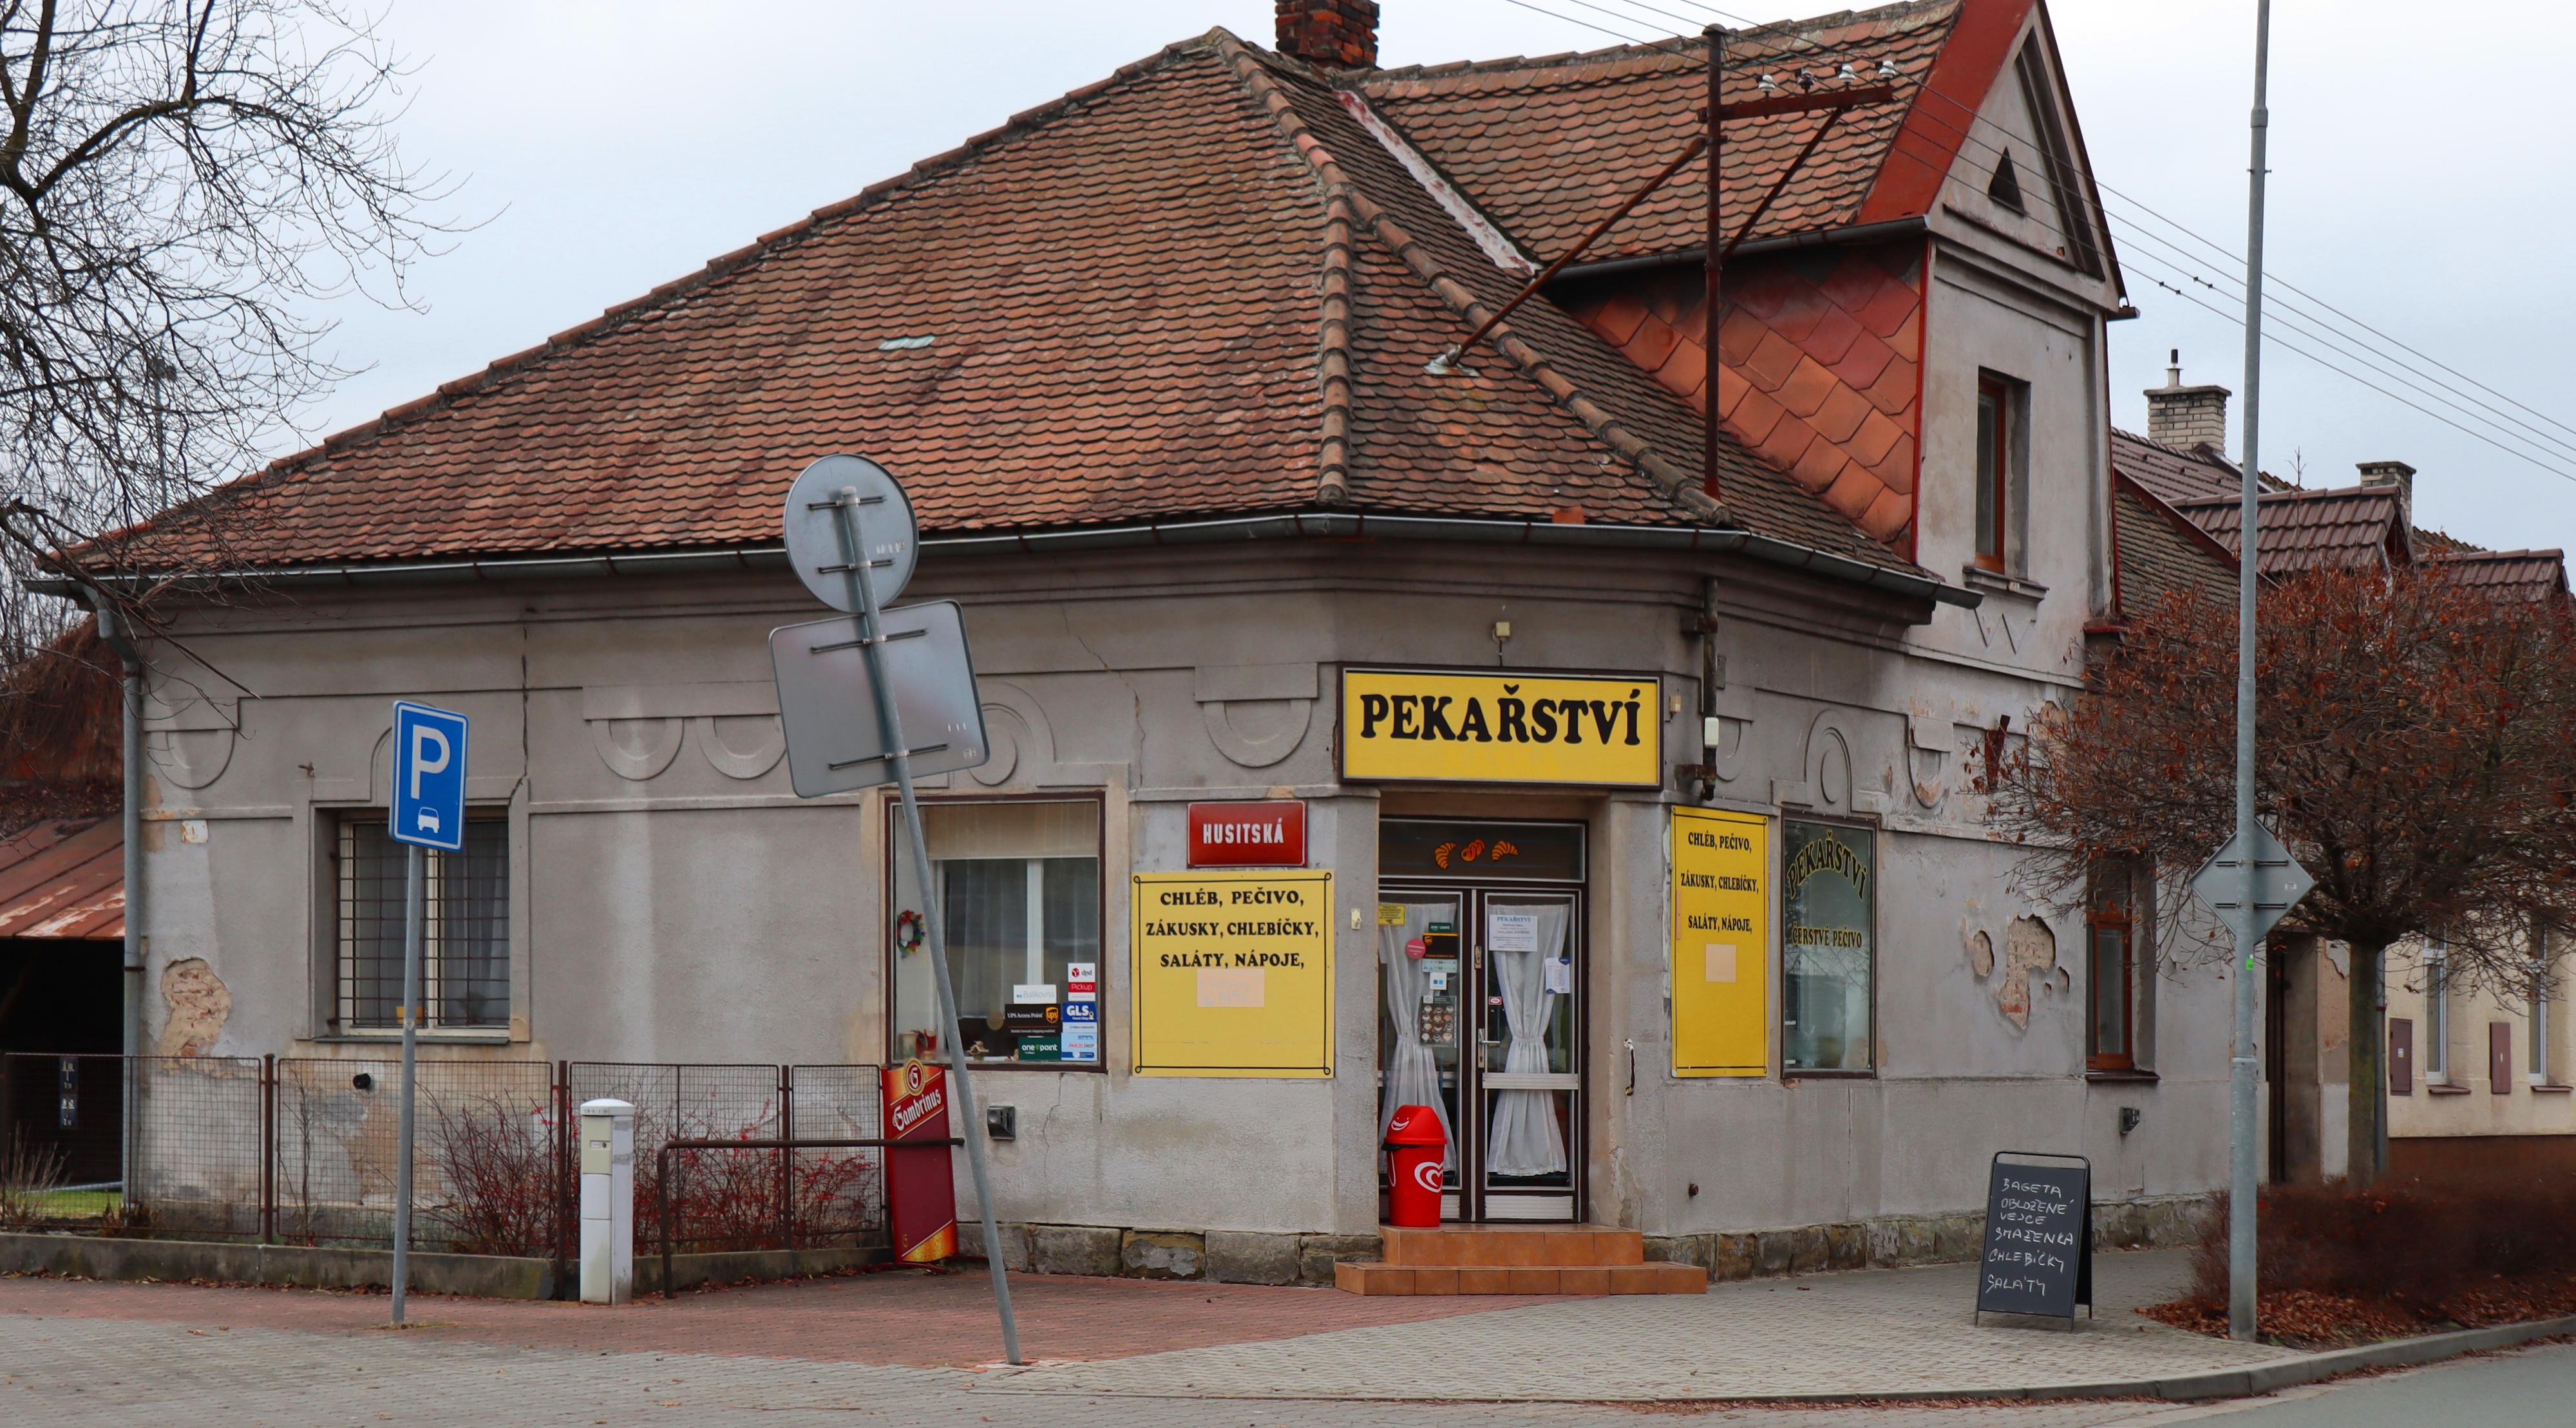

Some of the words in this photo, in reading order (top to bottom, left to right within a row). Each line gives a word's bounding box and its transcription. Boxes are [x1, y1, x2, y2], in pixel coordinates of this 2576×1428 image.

[1360, 684, 1641, 746] PEKAŘSTVÍ
[410, 724, 450, 800] P
[1203, 817, 1284, 844] HUSITSKÁ
[1688, 831, 1718, 850] CHLÉB,
[1719, 833, 1752, 854] PEČIVO,
[1786, 829, 1867, 901] PEKAŘSTVÍ
[1681, 869, 1717, 891] ZÁKUSKY,
[1719, 874, 1759, 894] CHLEBÍČKY,
[1160, 888, 1223, 908] CHLÉB,
[1231, 887, 1304, 907] PEČIVO,
[1146, 919, 1223, 938] ZÁKUSKY,
[1227, 918, 1319, 938] CHLEBÍČKY,
[1688, 913, 1719, 932] SALÁTY,
[1721, 914, 1752, 934] NÁPOJE,
[1792, 921, 1830, 947] ČERSTVÉ
[1833, 926, 1862, 948] PEČIVO
[1160, 950, 1228, 968] SALÁTY,
[1235, 949, 1305, 969] NÁPOJE,
[1071, 983, 1093, 991] Pickup
[1066, 1005, 1089, 1016] GLS
[1040, 1044, 1058, 1052] point
[892, 1089, 941, 1131] Gambrinus
[2002, 1178, 2061, 1198] BAGETA
[2000, 1212, 2047, 1224] VEJCE
[1985, 1273, 2045, 1296] SALÁTY
